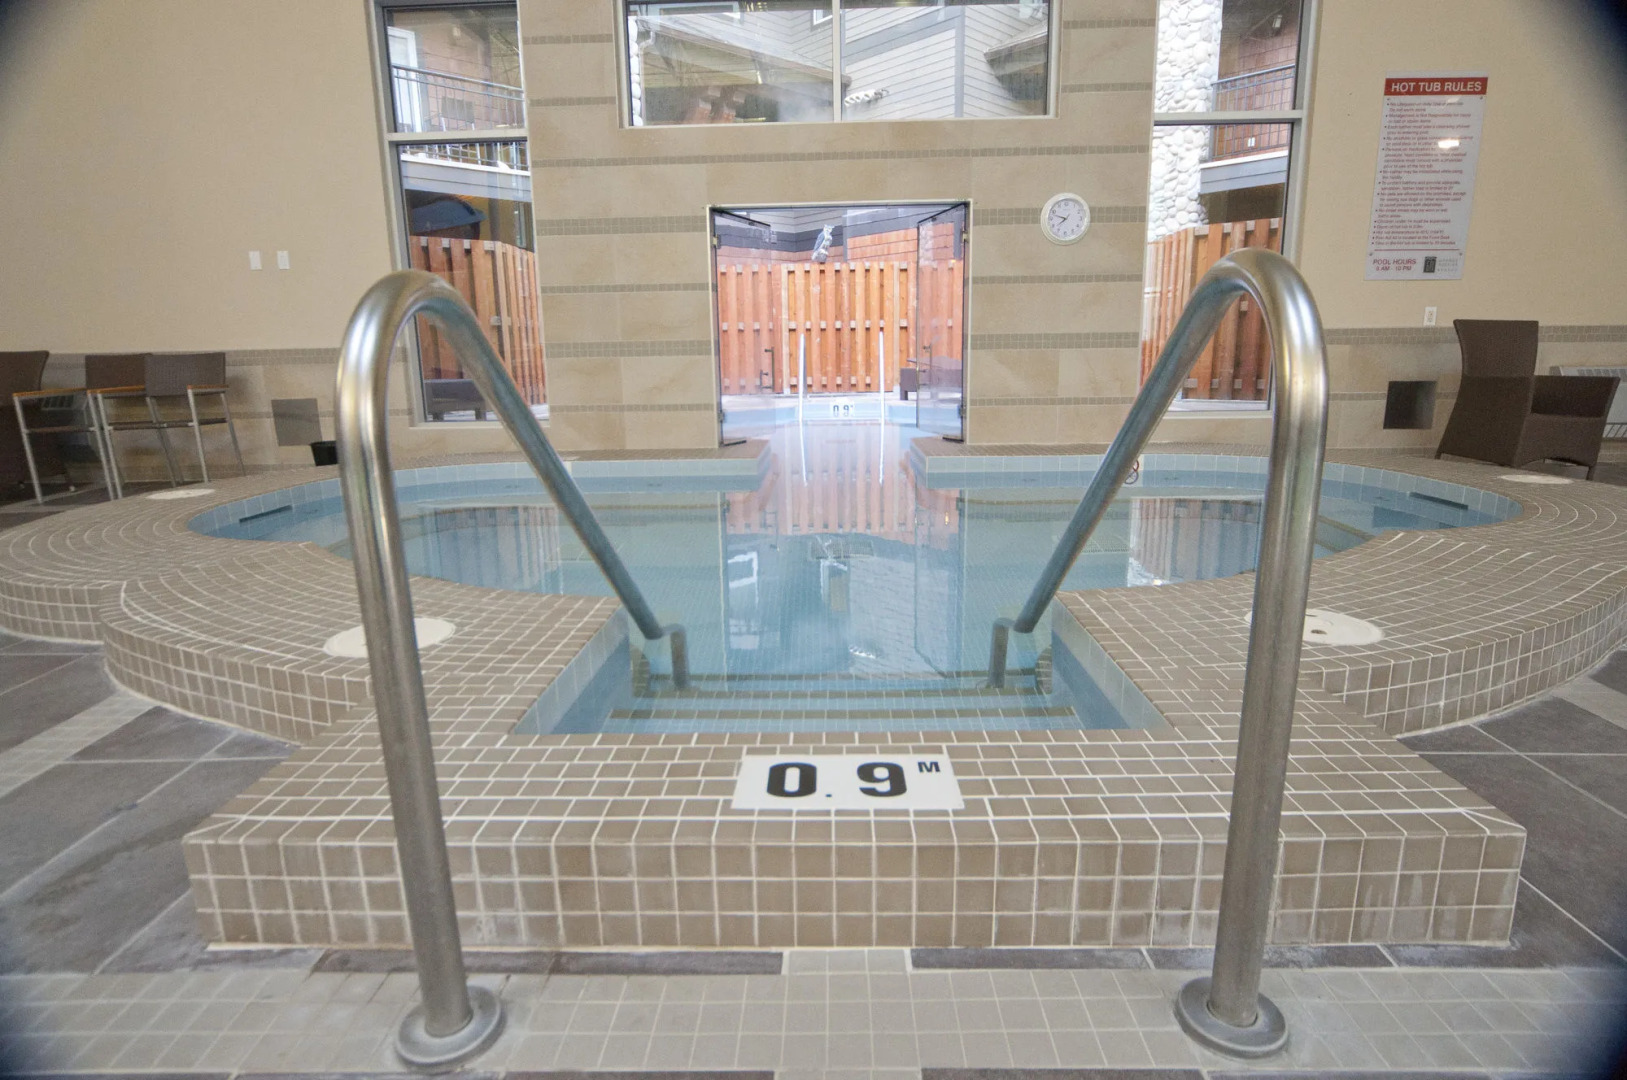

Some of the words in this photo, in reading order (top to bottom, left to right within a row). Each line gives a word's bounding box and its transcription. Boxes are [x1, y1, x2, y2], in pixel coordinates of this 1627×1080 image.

[1391, 82, 1416, 92] HOT
[1419, 82, 1441, 92] TUB
[1444, 81, 1482, 92] RULES
[1373, 258, 1391, 266] POOL
[766, 761, 908, 798] 0.9
[917, 761, 941, 773] M
